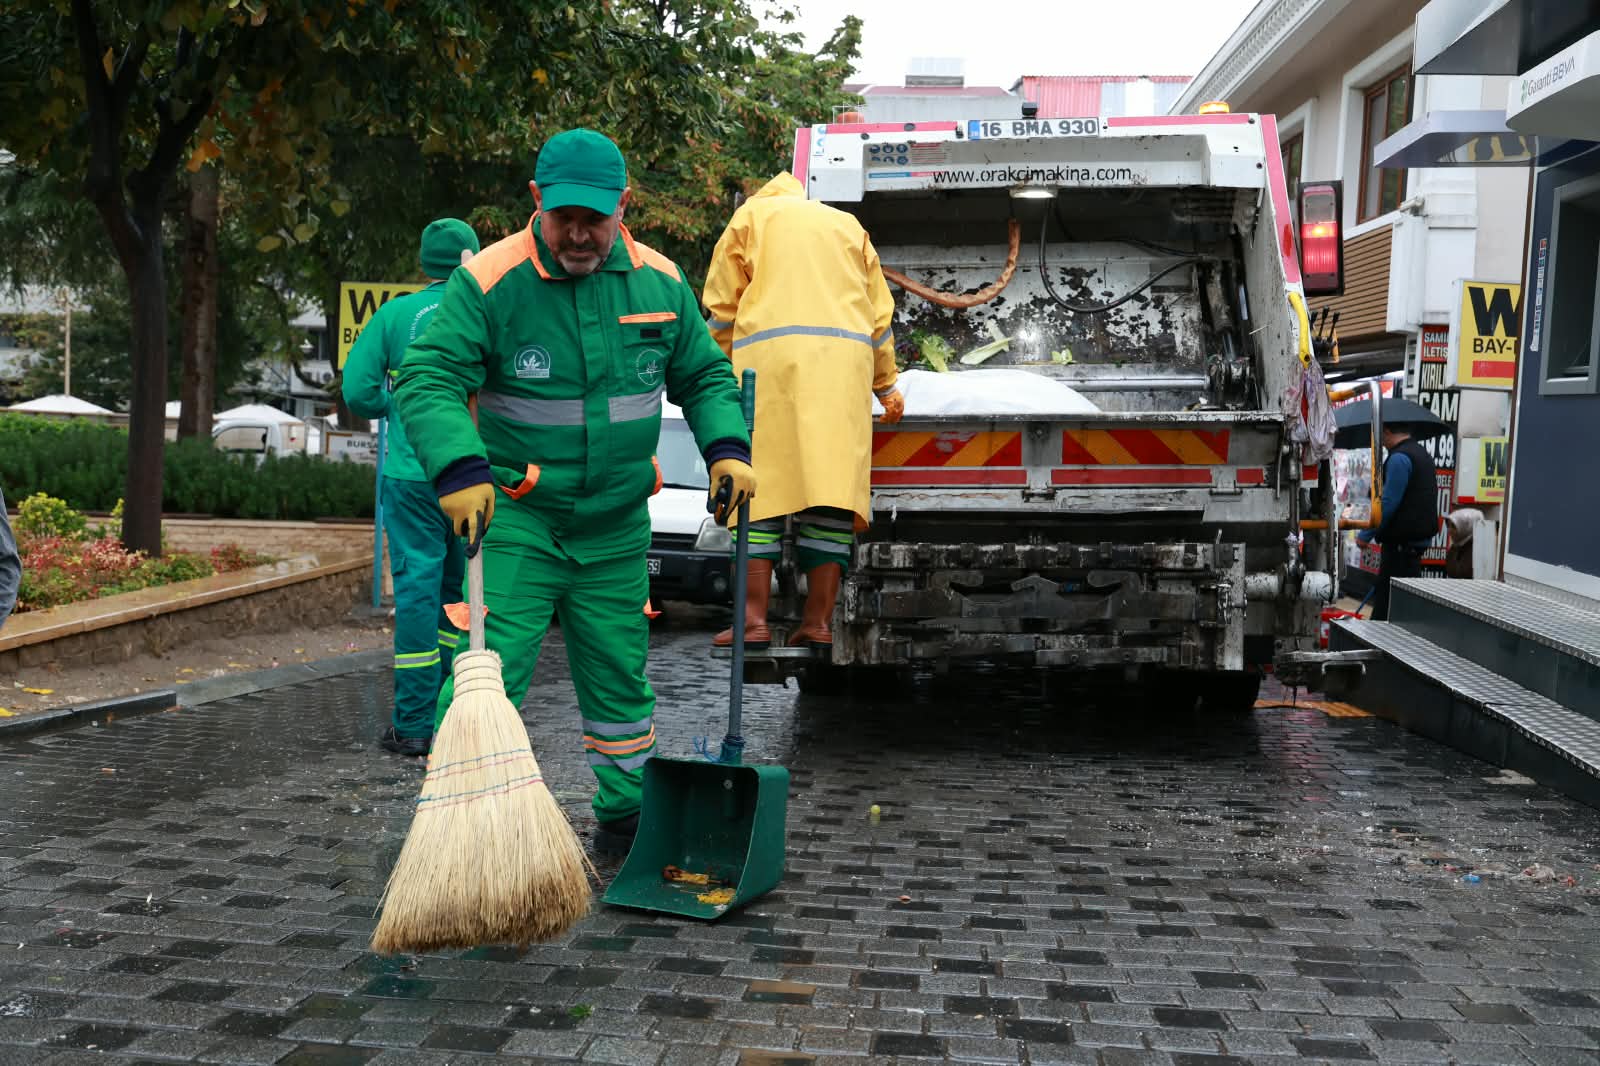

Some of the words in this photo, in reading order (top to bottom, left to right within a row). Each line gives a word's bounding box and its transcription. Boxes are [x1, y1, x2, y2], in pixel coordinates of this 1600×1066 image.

[1528, 70, 1552, 96] Garanti
[1552, 56, 1575, 82] BBVA
[981, 120, 1002, 137] 16
[1013, 119, 1053, 136] BMA
[1059, 118, 1097, 135] 930
[348, 289, 414, 325] W
